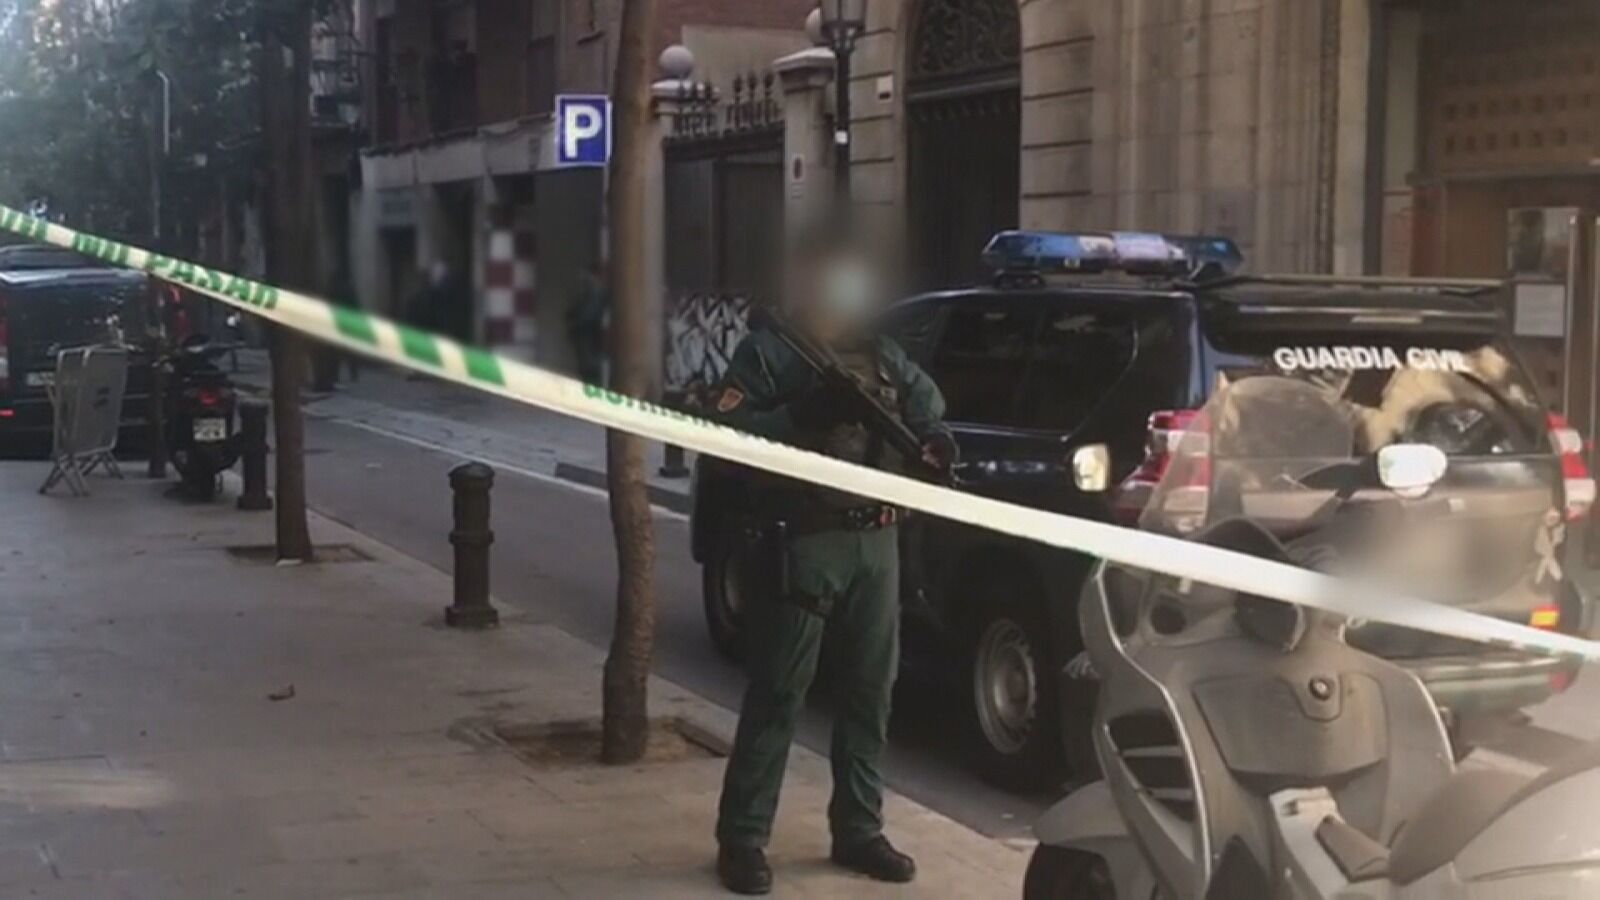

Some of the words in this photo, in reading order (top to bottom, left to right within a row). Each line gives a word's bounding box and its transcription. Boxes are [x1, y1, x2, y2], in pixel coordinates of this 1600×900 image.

[565, 104, 602, 158] P
[1273, 346, 1403, 370] GUARDIA
[1406, 347, 1473, 374] CIVIL
